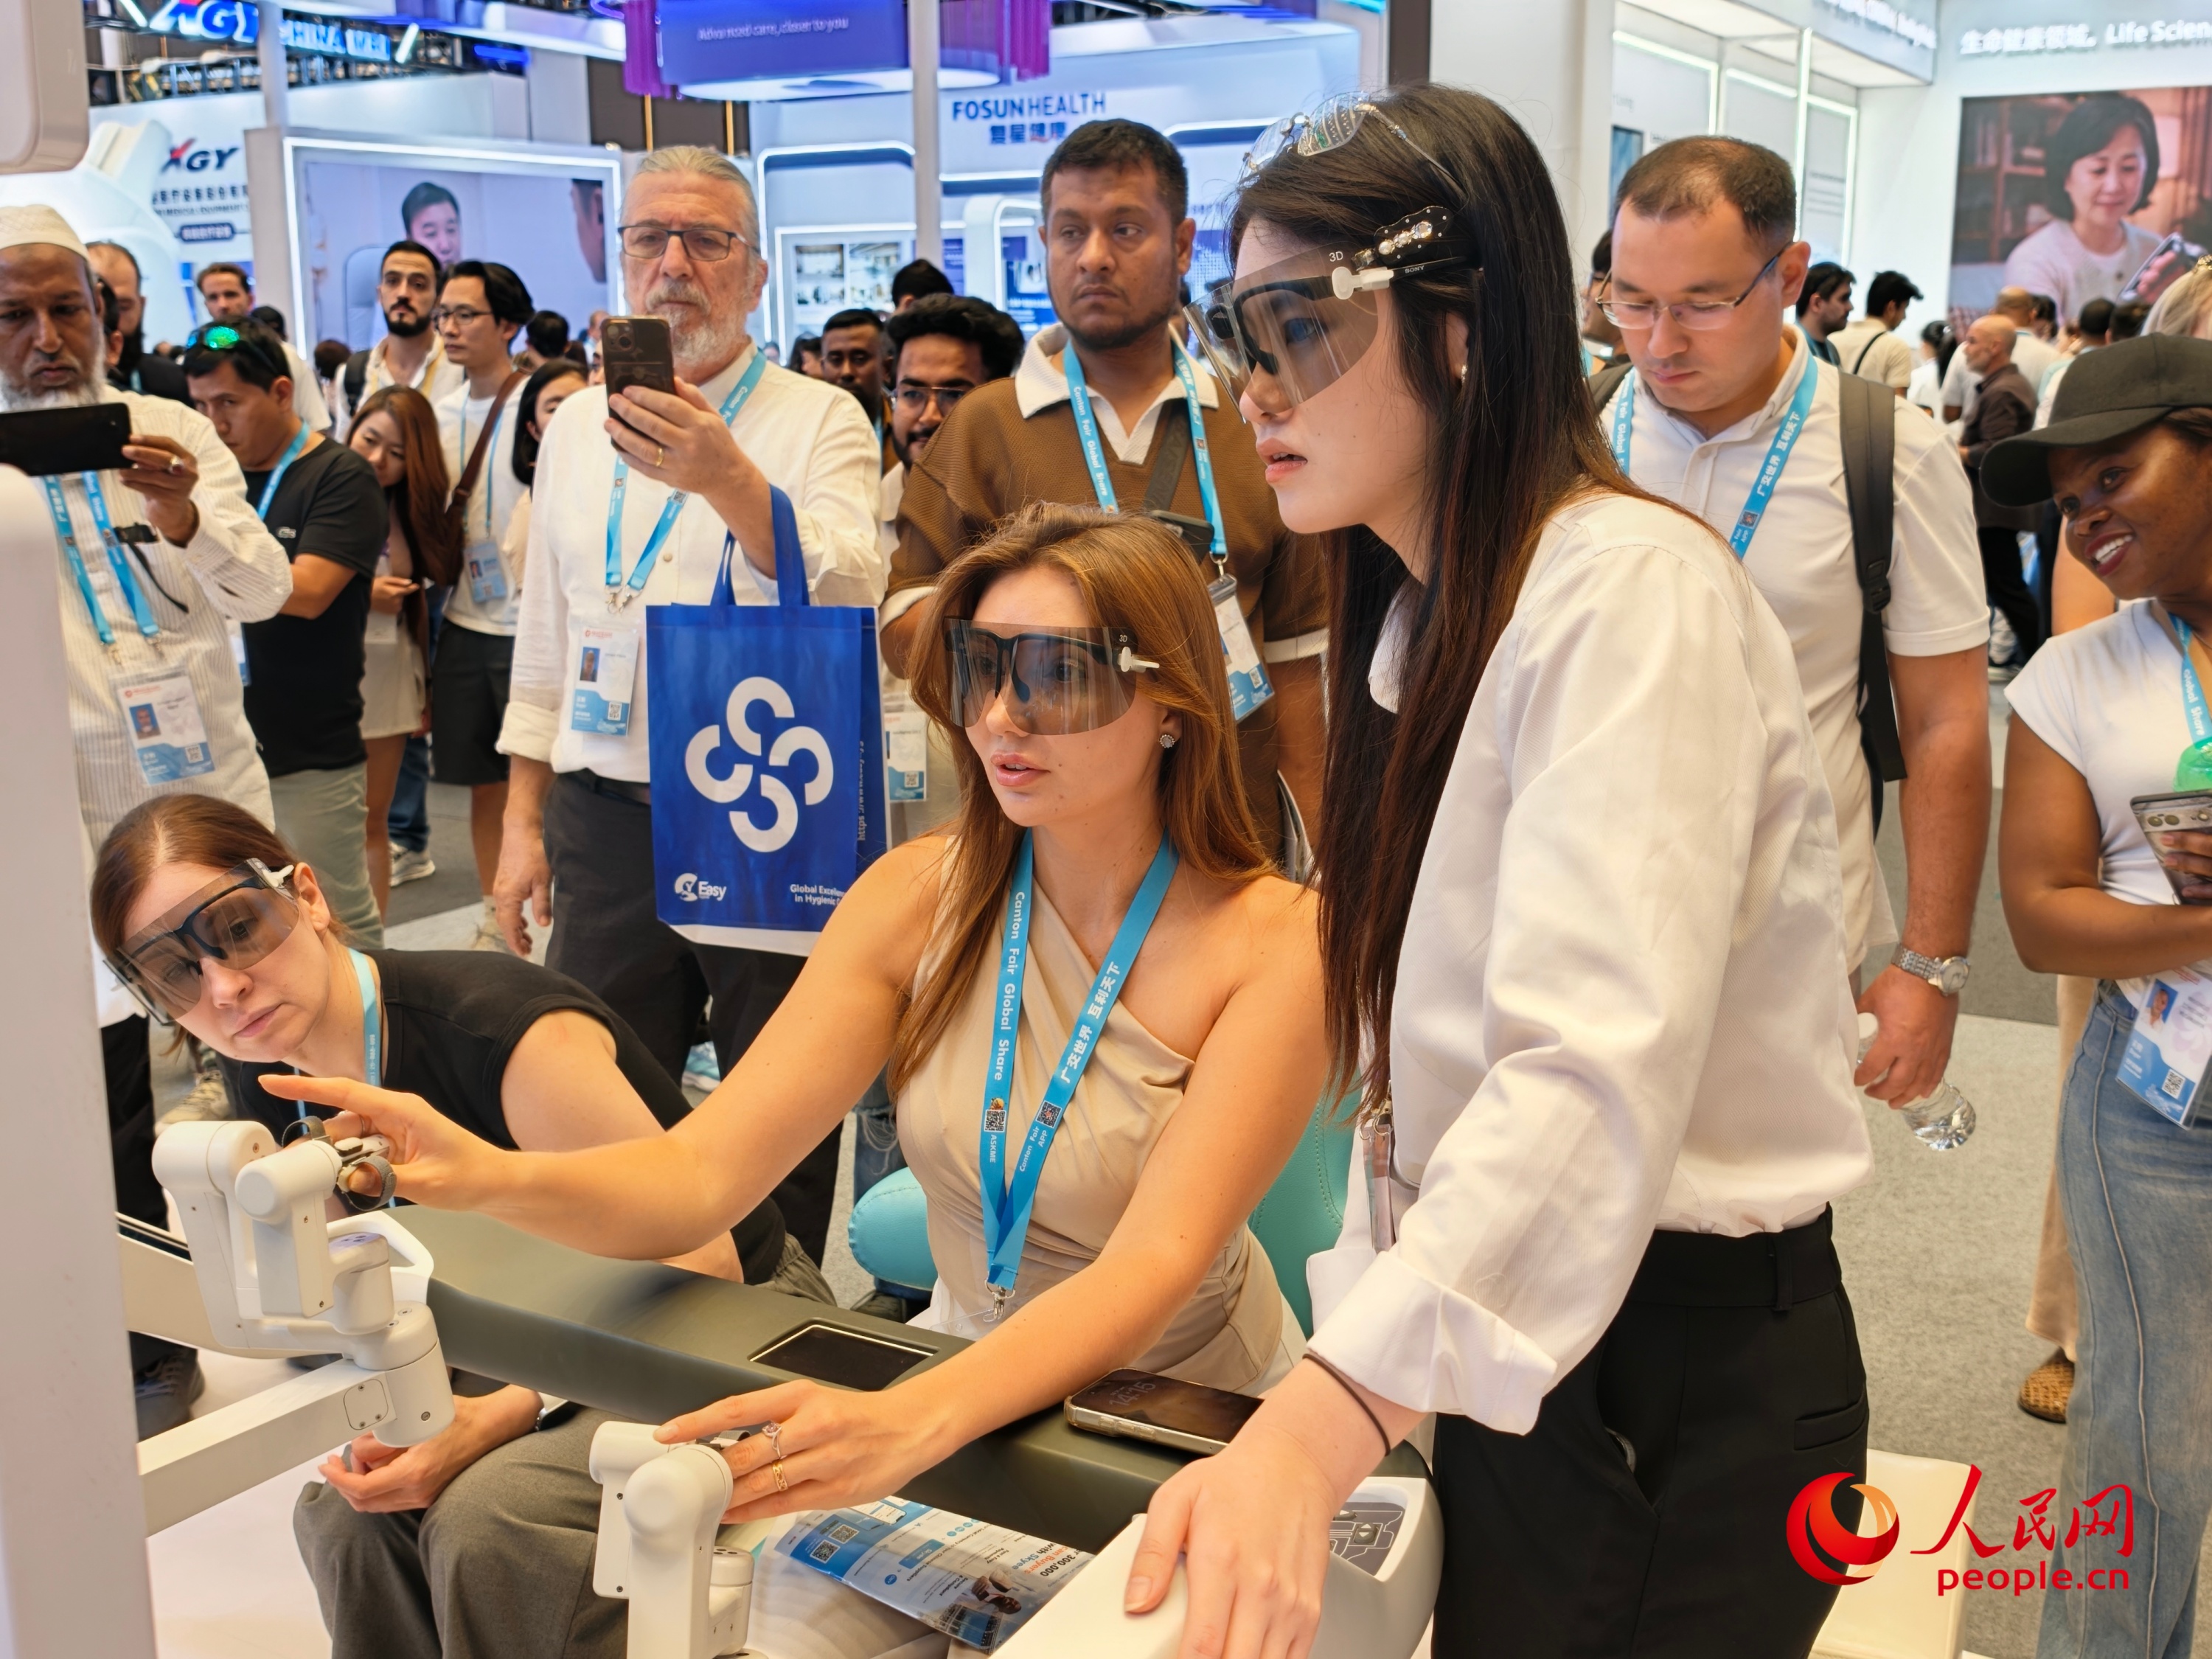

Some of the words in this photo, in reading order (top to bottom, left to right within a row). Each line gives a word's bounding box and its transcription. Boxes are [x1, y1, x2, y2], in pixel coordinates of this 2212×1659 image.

[826, 18, 849, 33] you
[2104, 21, 2149, 44] Life
[160, 138, 240, 174] XGY
[1329, 251, 1343, 262] 3D
[1404, 265, 1425, 274] SONY
[728, 385, 748, 409] Canton
[1073, 386, 1086, 416] Canton
[1082, 419, 1092, 437] Fair
[1087, 439, 1102, 469] Global
[1096, 472, 1108, 497] Share
[1616, 422, 1627, 453] Global
[1119, 634, 1128, 642] 3D
[2183, 668, 2199, 703] Global
[2190, 706, 2205, 736] Share
[698, 881, 727, 901] Easy
[790, 883, 817, 894] Global
[795, 894, 803, 903] in
[1010, 891, 1026, 939] Canton
[1006, 947, 1020, 975] Fair
[1001, 983, 1016, 1030] Global
[1060, 1024, 1093, 1084] 广交世界
[1087, 961, 1121, 1019] 互利天下
[994, 1039, 1009, 1081] Share
[1019, 1145, 1032, 1172] Canton
[1029, 1126, 1040, 1142] Fair
[1037, 1130, 1048, 1147] APP
[1109, 1381, 1156, 1406] 14:15
[1012, 1553, 1040, 1570] Skyee
[1023, 1554, 1056, 1575] Buyers
[1040, 1554, 1077, 1576] 300,000
